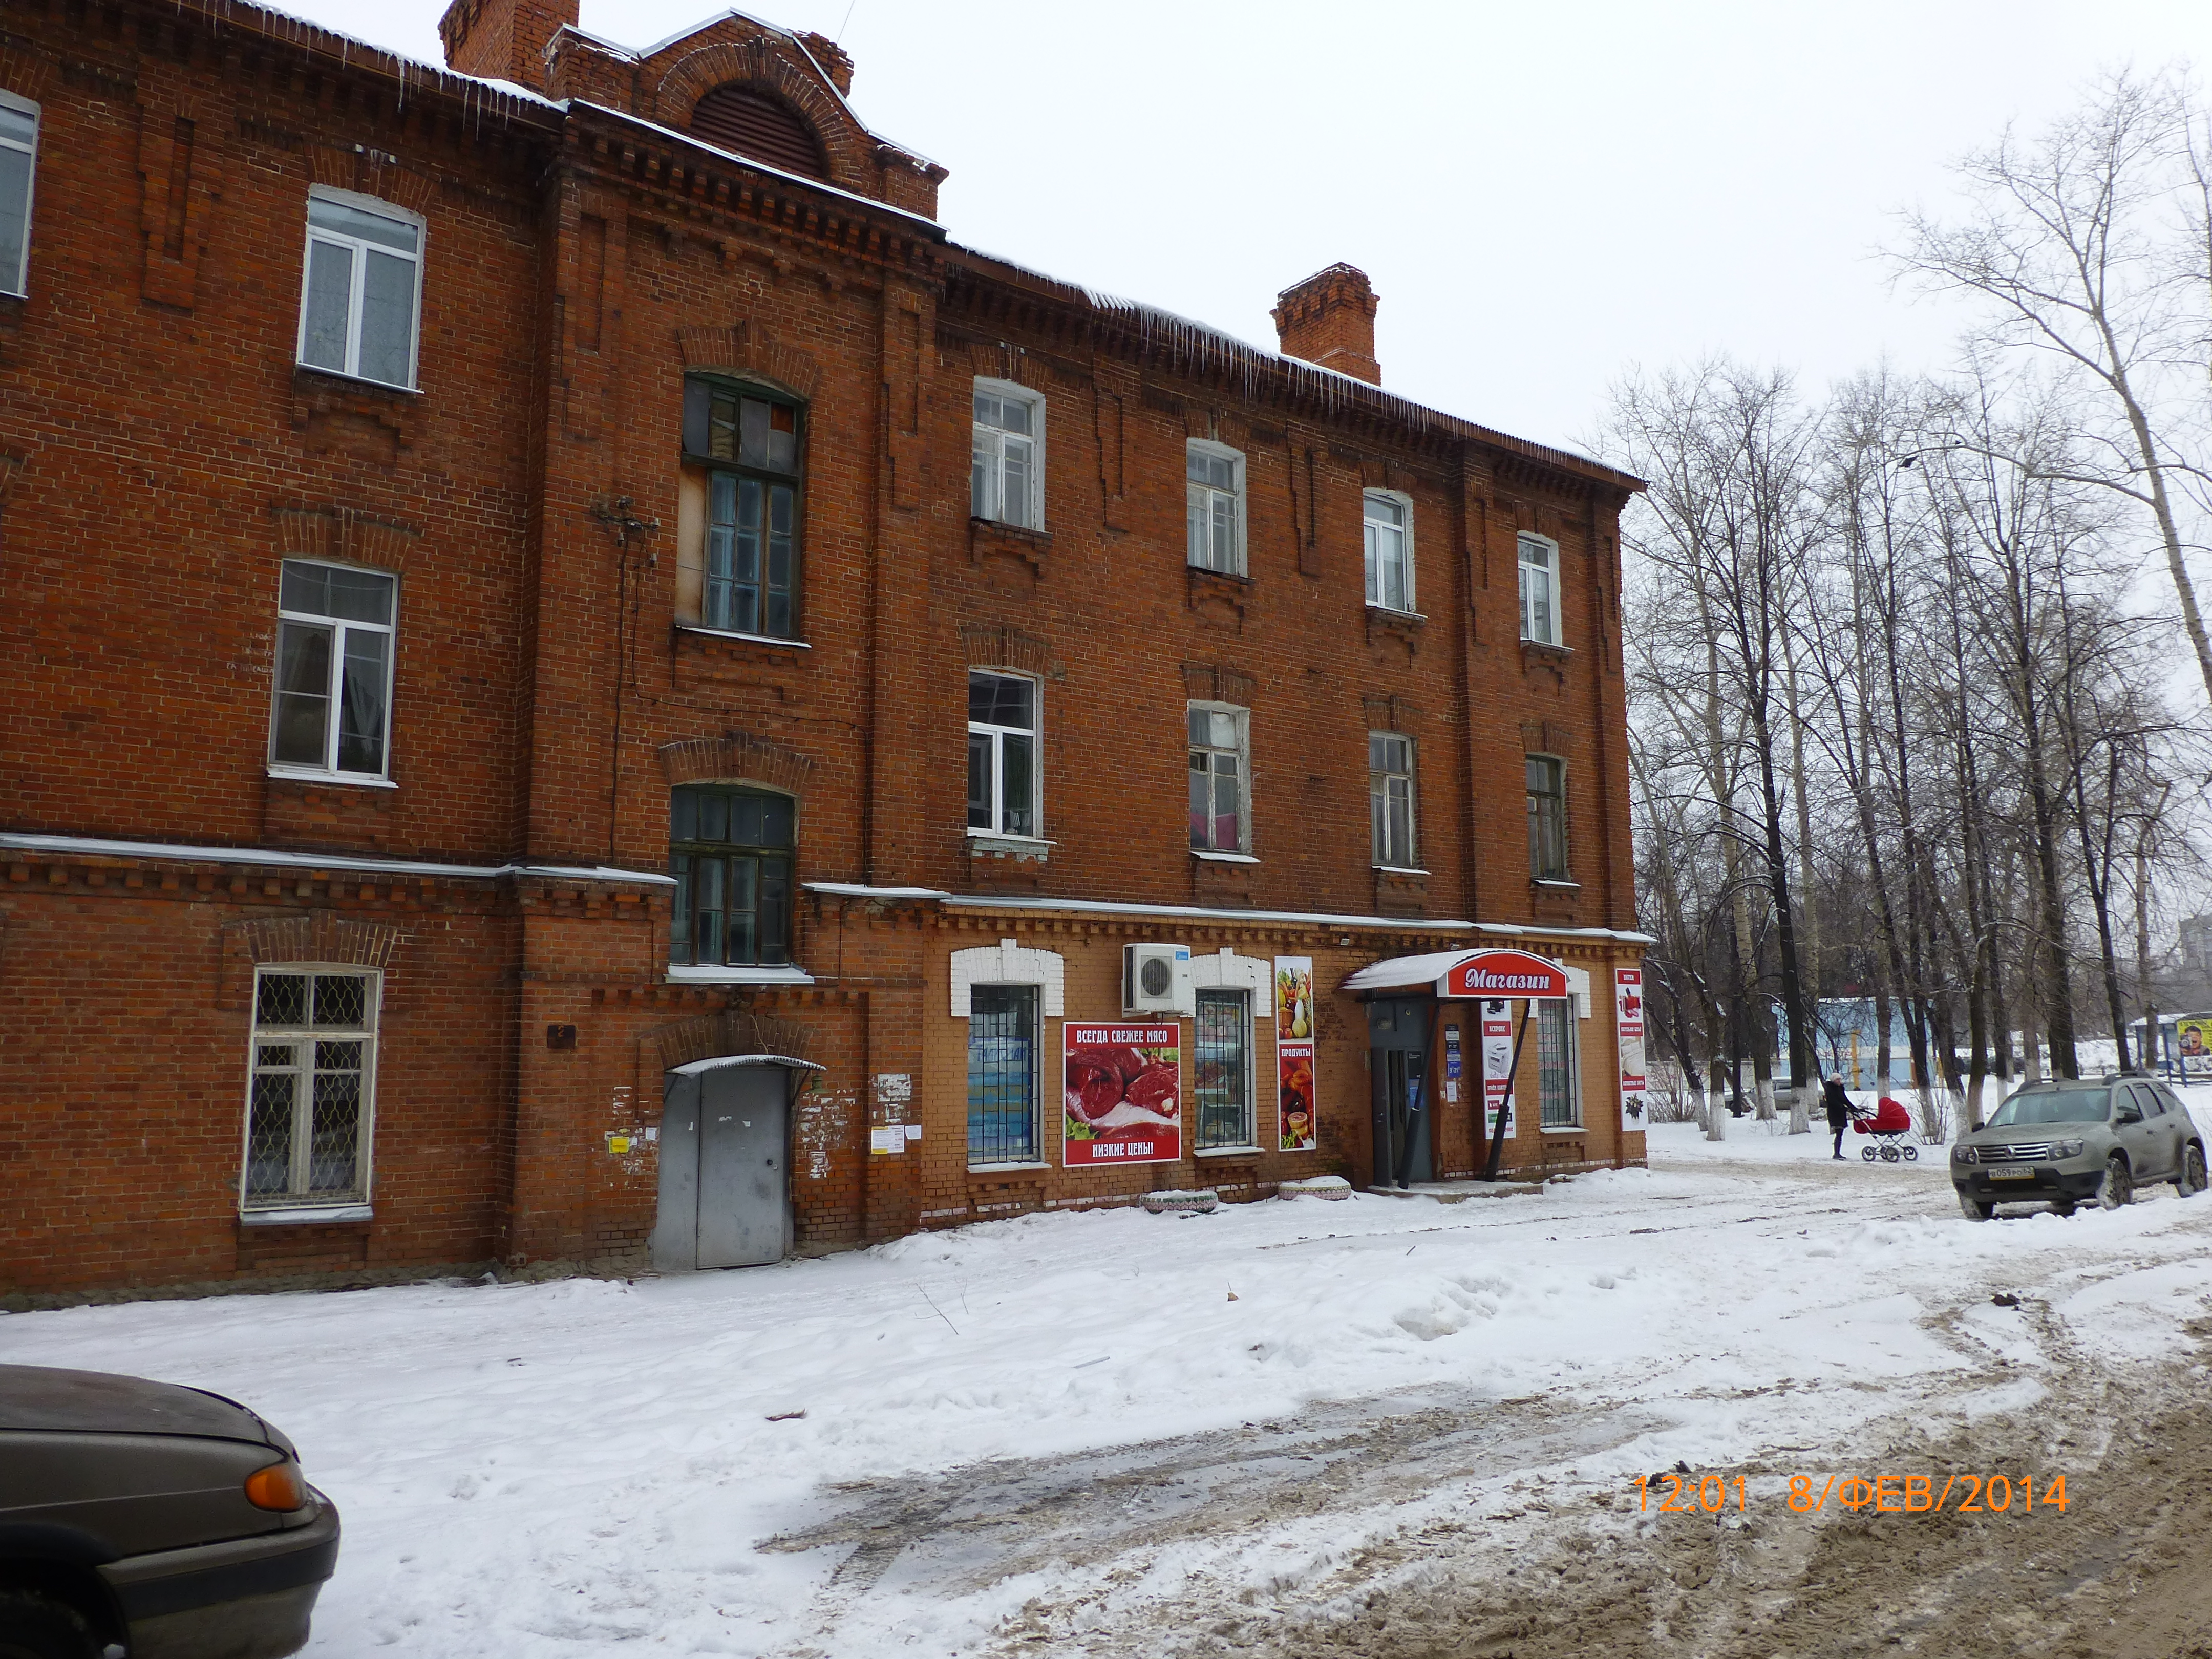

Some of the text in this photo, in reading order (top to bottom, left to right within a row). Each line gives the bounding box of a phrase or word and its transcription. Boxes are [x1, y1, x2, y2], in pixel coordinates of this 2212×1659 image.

[1465, 968, 1550, 989] Магазин
[1076, 1030, 1168, 1044] ВСЕГДА СВЕЖЕЕ МЯСО
[1281, 1048, 1311, 1057] ПРОДУКТЫ
[1092, 1142, 1154, 1158] НИЗКИЕ ЦЕНЫ!
